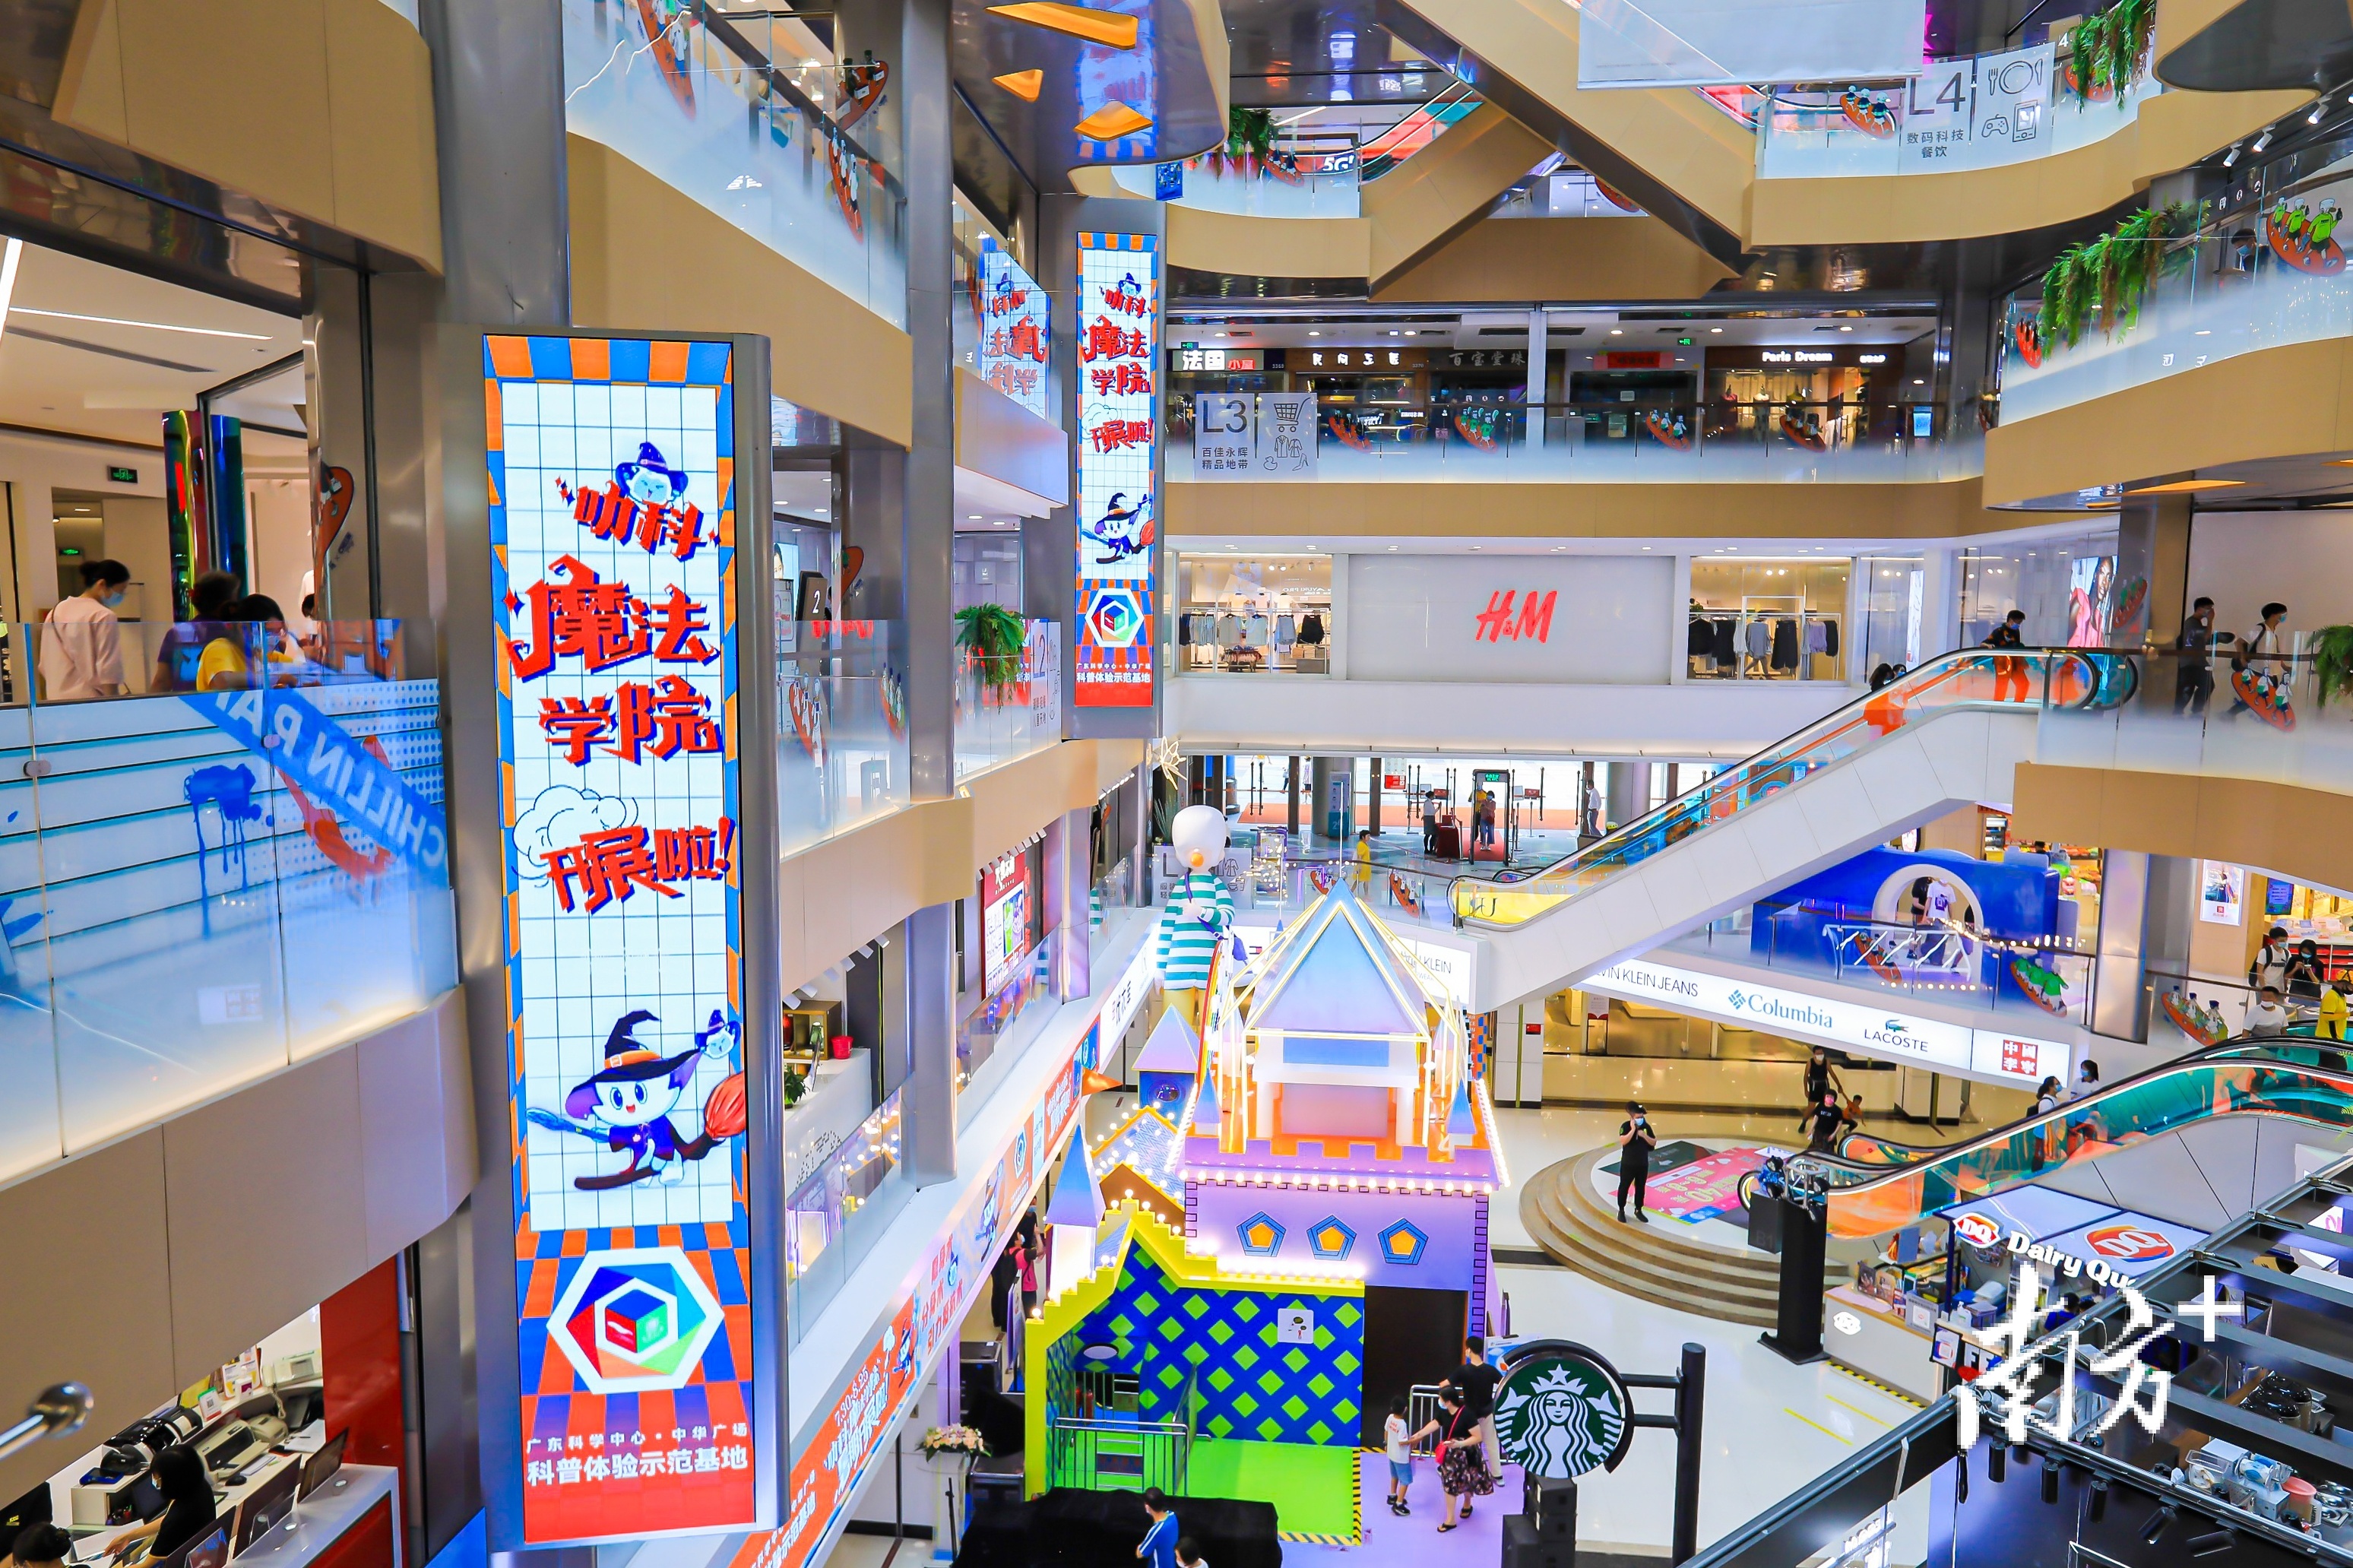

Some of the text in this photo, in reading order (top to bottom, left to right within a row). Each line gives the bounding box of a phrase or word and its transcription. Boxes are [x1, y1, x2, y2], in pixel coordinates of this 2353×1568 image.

[1908, 71, 1966, 116] L4
[1907, 128, 1965, 144] 数码科技
[1921, 145, 1947, 159] 餐饮
[1082, 315, 1151, 363] 魔法
[1794, 351, 1833, 363] Dream
[1091, 362, 1151, 396] 学院
[1203, 400, 1247, 433] L3
[1202, 447, 1248, 458] 百佳永辉
[1202, 459, 1248, 470] 精品地带
[506, 553, 720, 682] 魔法
[1475, 590, 1557, 643] H&M
[538, 673, 722, 765] 学院
[1163, 852, 1179, 877] L
[1622, 972, 1657, 988] KLEIN
[1657, 977, 1699, 997] JEANS
[1748, 993, 1833, 1028] Columbia
[1864, 1028, 1929, 1053] LACOSTE
[2007, 1230, 2084, 1278] Dairy
[527, 1445, 749, 1487] 科普体验示范基地
